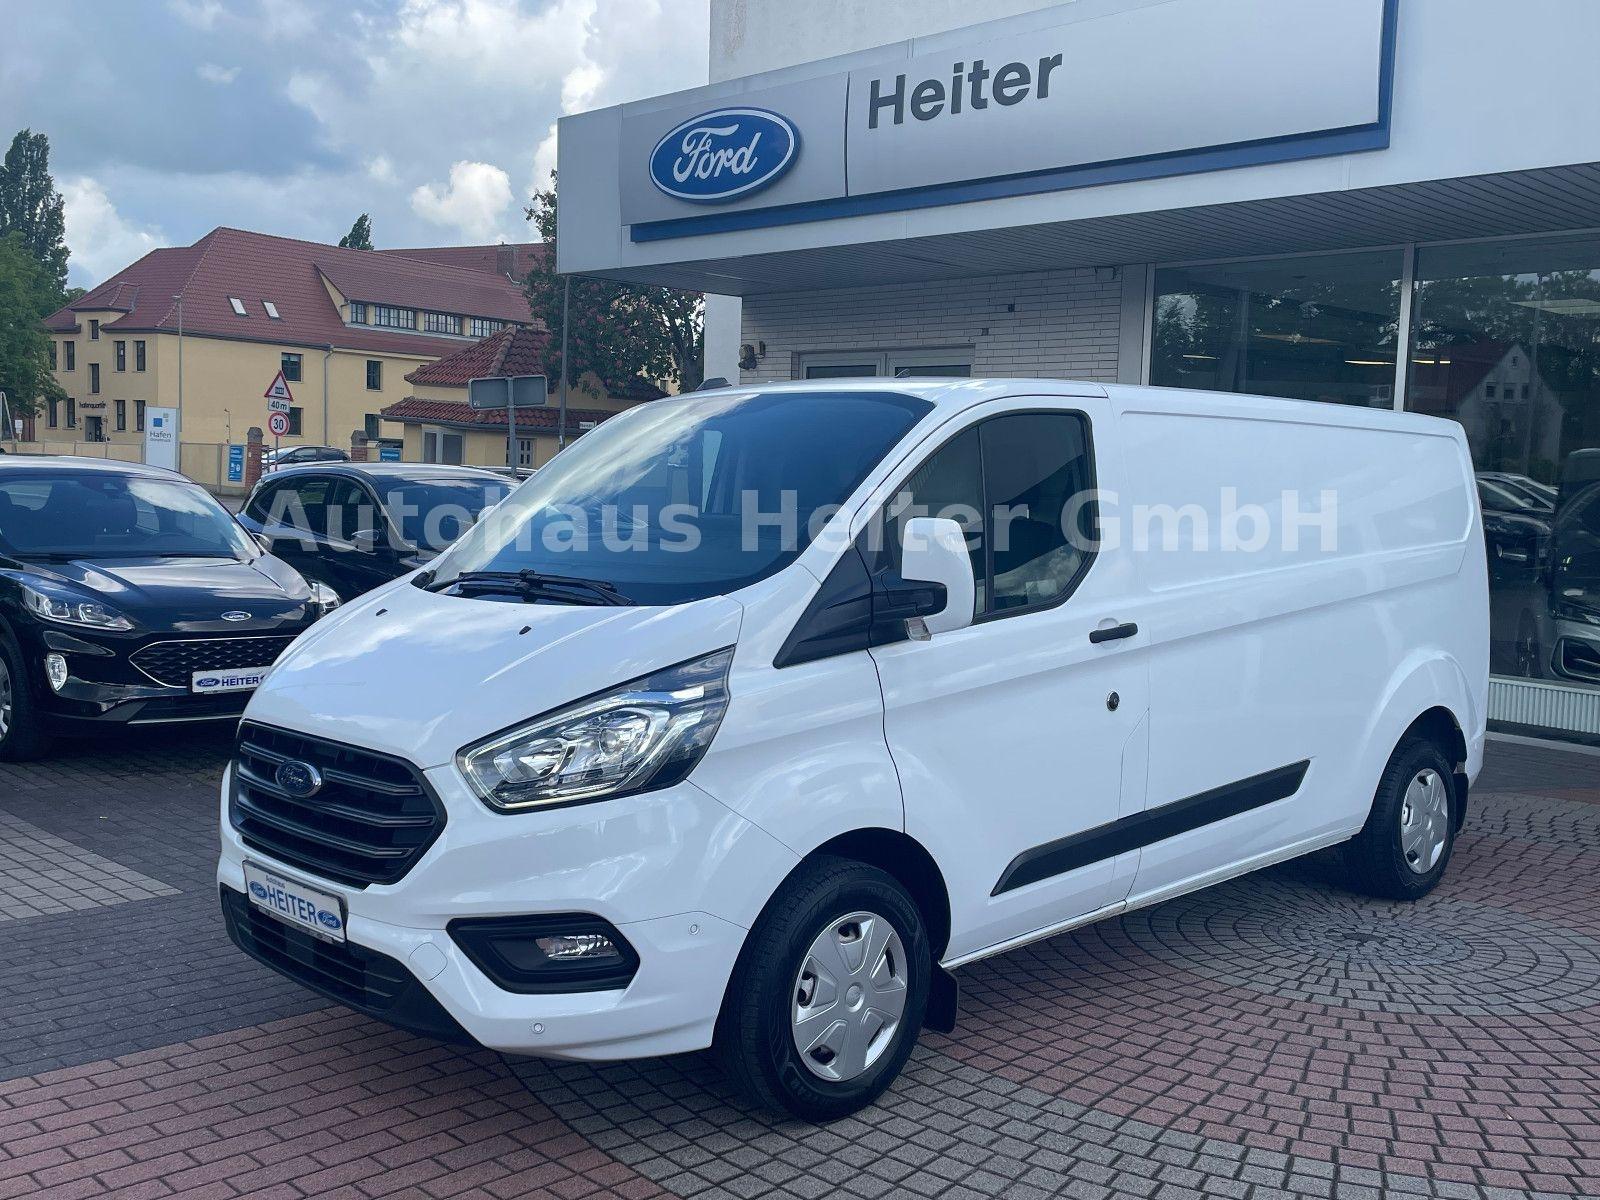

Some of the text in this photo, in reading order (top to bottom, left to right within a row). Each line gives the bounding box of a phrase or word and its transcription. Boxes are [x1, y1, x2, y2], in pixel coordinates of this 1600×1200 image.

[868, 53, 1063, 129] Heiter
[673, 123, 760, 183] Ford
[271, 400, 288, 411] 40 m
[273, 418, 284, 430] 30
[150, 430, 171, 438] Hafen
[222, 676, 259, 686] HEITER
[266, 884, 318, 926] HEITER
